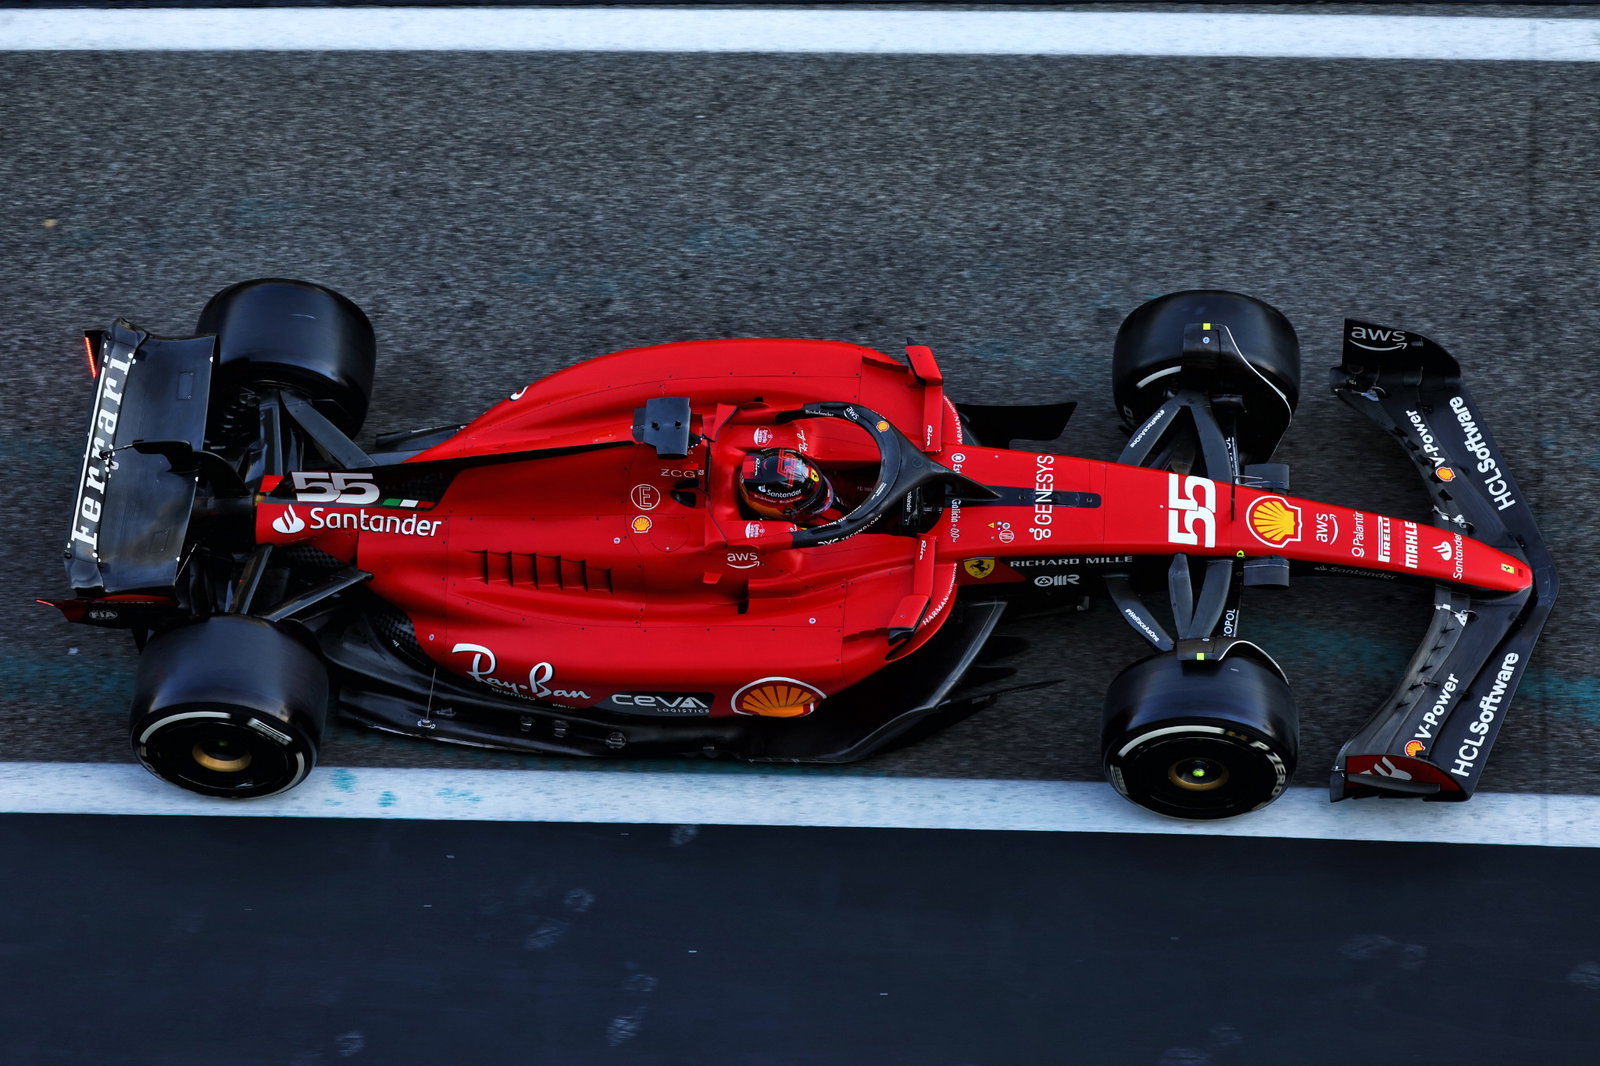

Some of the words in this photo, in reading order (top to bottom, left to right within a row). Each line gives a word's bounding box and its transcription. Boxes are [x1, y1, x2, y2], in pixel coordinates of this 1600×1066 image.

[1351, 326, 1407, 343] aws
[71, 356, 132, 551] Ferrari
[1405, 409, 1446, 467] V-Power
[1449, 395, 1516, 511] HCLSoftware
[290, 470, 381, 505] 55
[1034, 455, 1055, 526] GENESYS
[1168, 473, 1217, 549] 55
[310, 507, 442, 537] Santander
[1353, 511, 1365, 547] Palantir
[1377, 515, 1391, 563] PIRELLI
[1405, 521, 1418, 569] MAHLE
[727, 552, 759, 563] aws
[1010, 558, 1080, 567] RICHARD
[1086, 555, 1133, 565] MILLE
[1329, 566, 1398, 580] Santander
[1452, 532, 1464, 580] Santander
[922, 596, 949, 626] HARMAN
[1223, 608, 1236, 637] OPOL
[452, 643, 591, 699] Ray-Ban
[1414, 673, 1460, 740] V-Power
[1450, 652, 1519, 778] HCLSoftware
